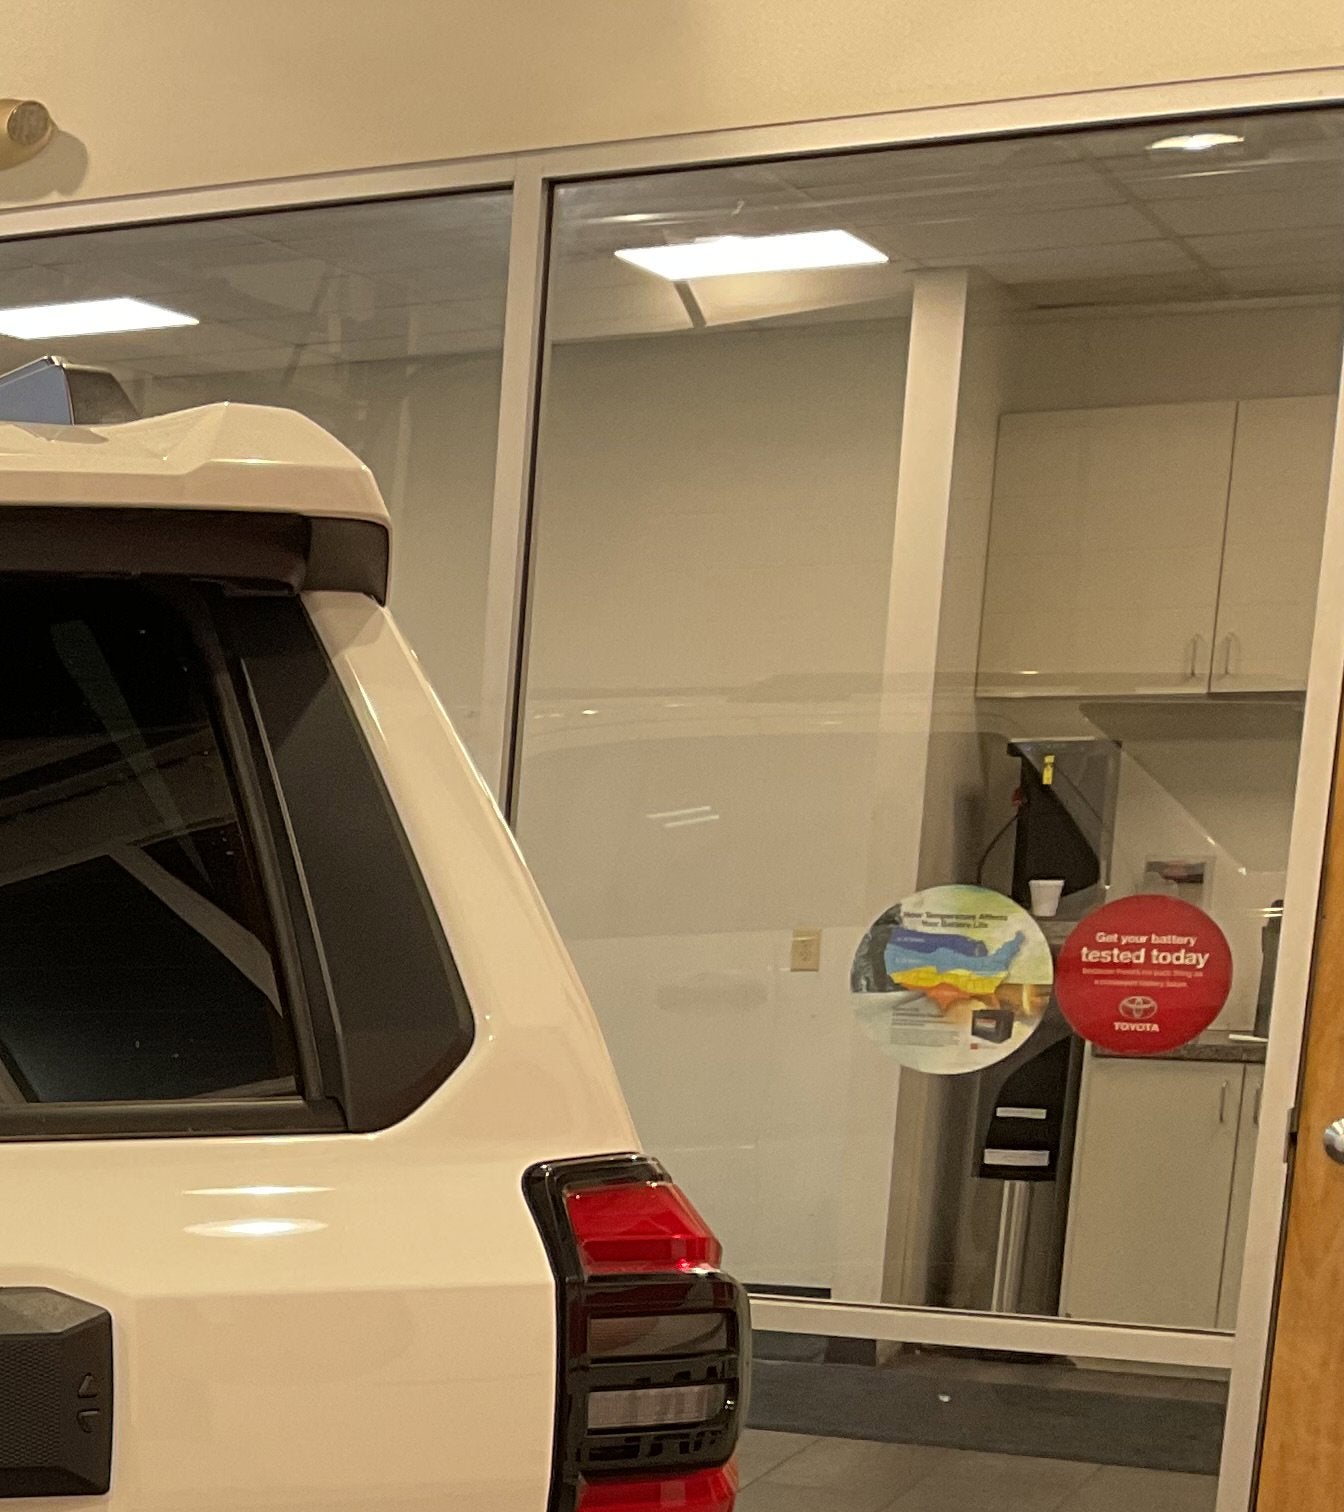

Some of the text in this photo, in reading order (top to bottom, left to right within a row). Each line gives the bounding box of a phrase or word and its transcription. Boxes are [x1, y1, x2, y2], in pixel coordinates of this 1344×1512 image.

[1095, 931, 1197, 947] Get your battery
[1081, 946, 1210, 969] tested today
[1113, 1021, 1160, 1032] TOYOTA
